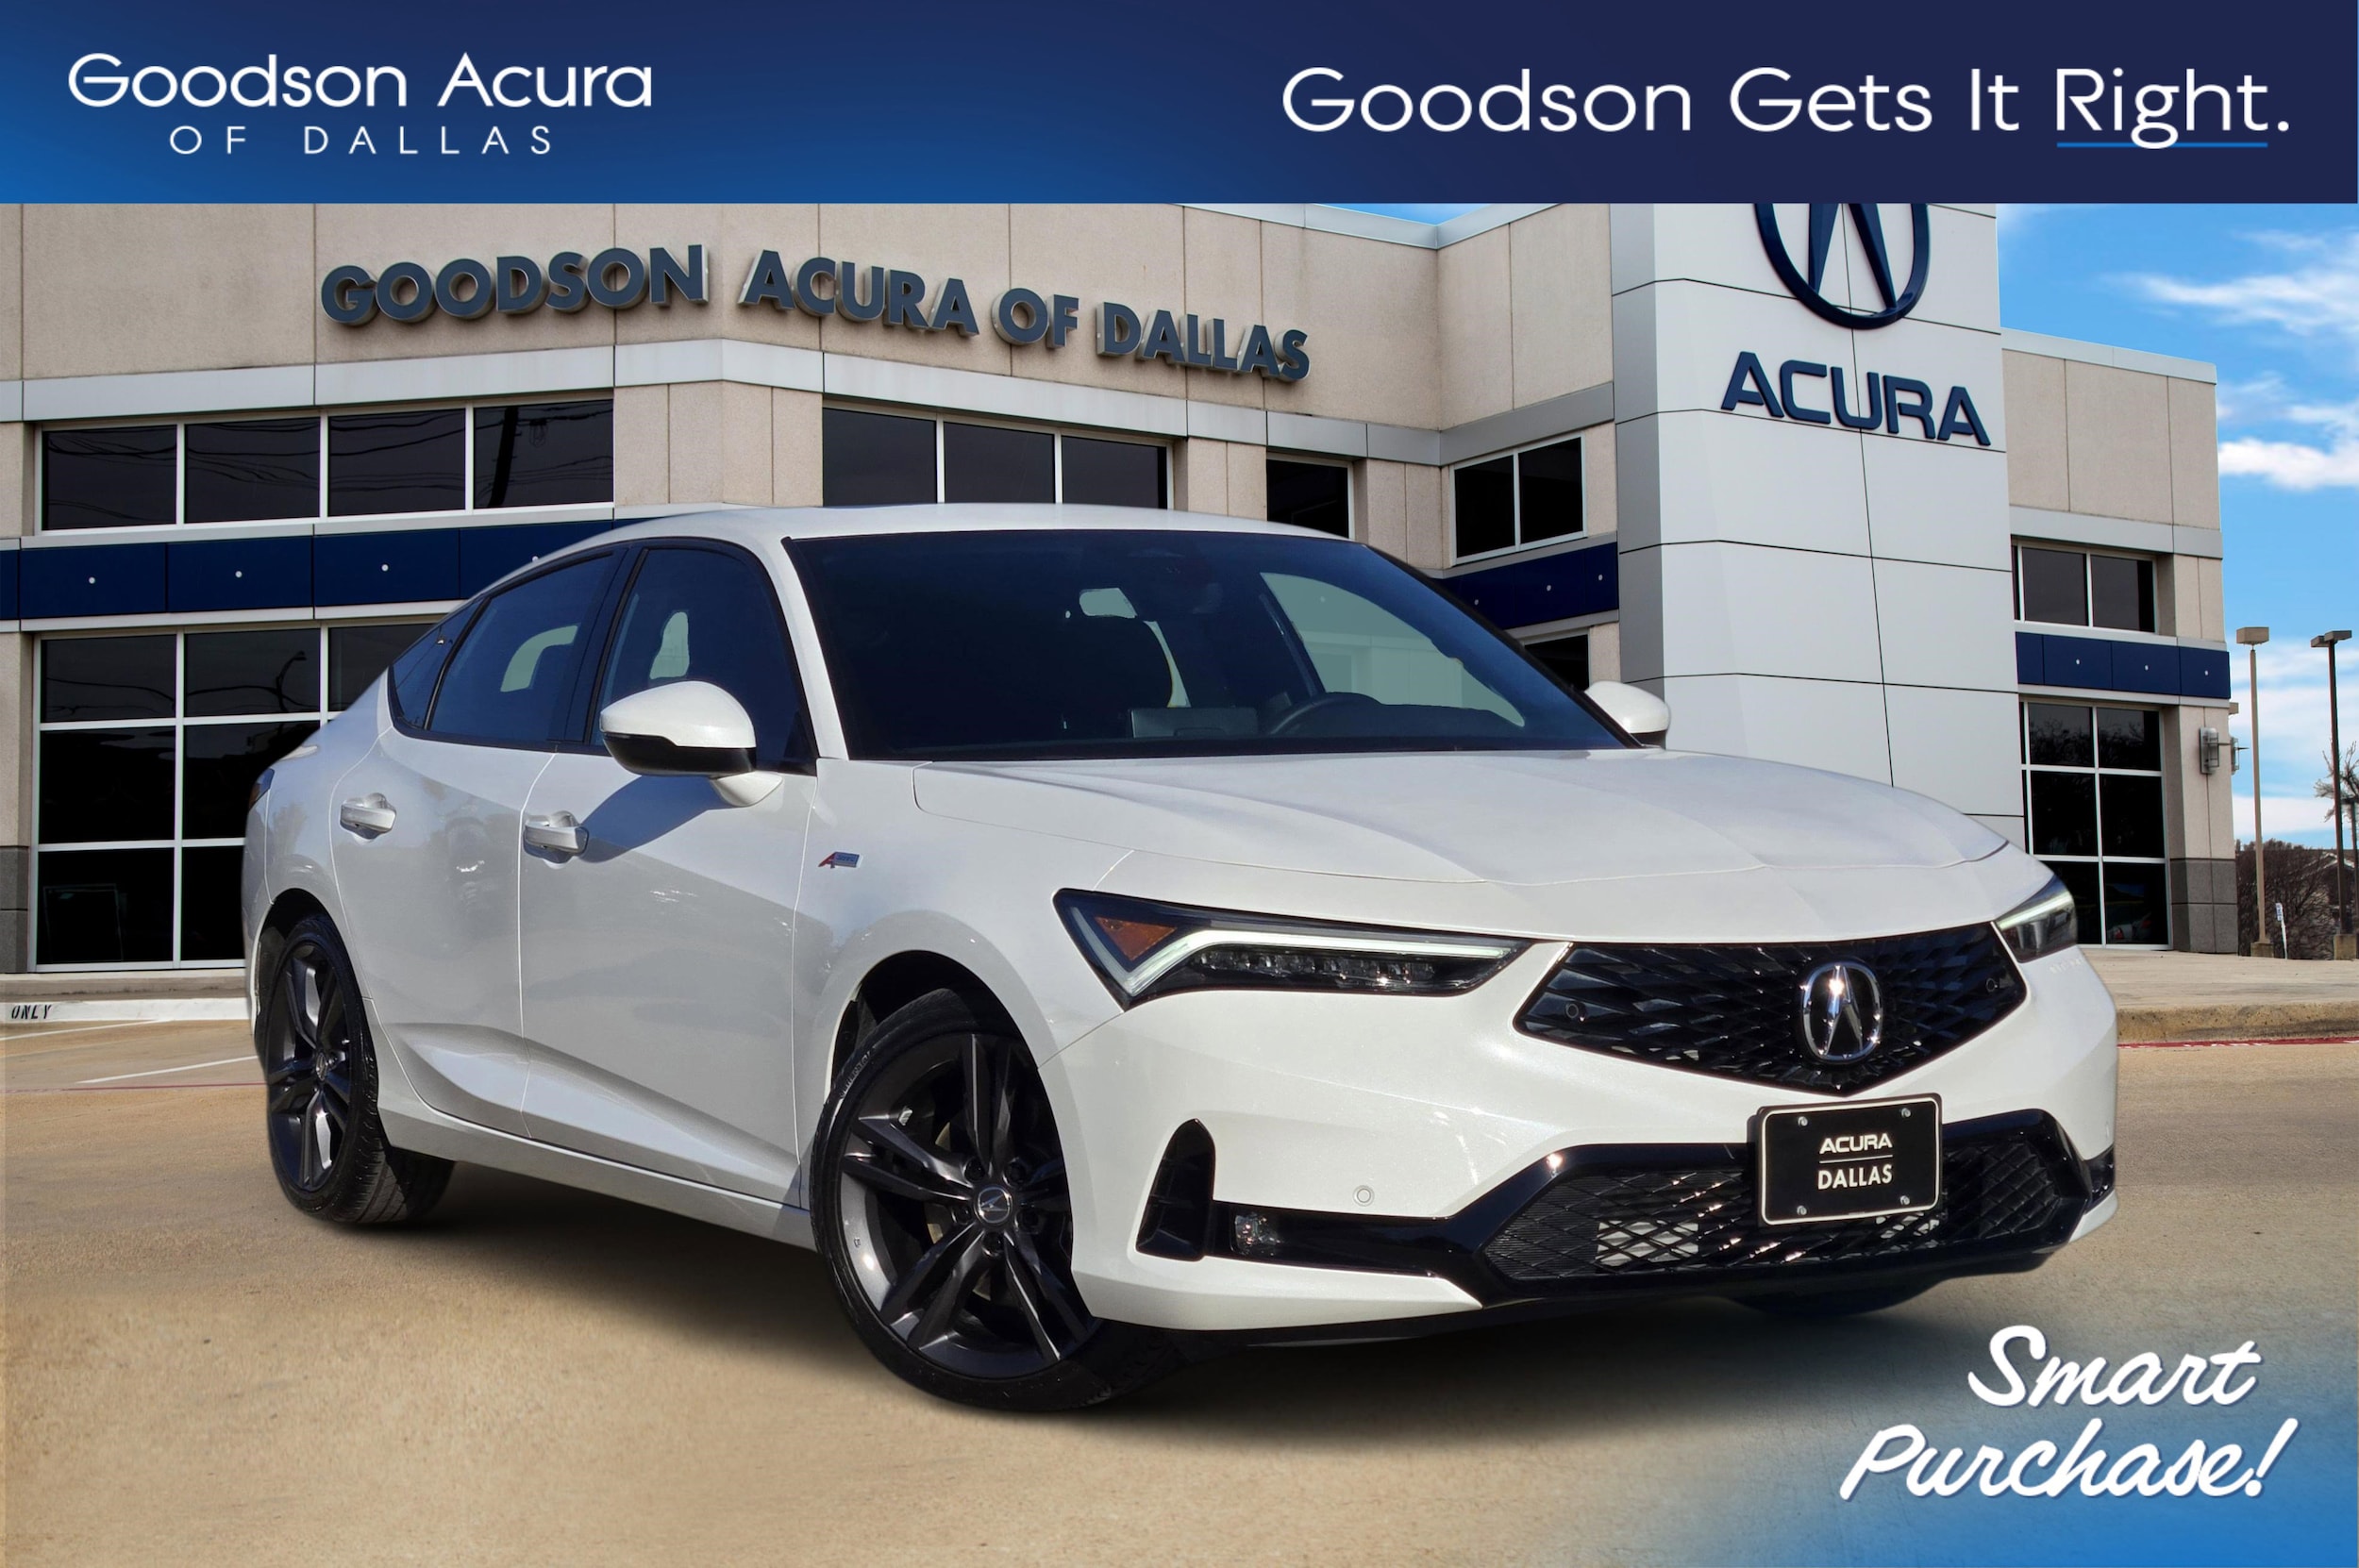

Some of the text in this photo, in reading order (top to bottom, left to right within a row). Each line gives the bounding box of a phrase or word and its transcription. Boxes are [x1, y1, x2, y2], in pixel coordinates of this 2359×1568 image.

[321, 243, 1312, 382] GOODSON ACURA OF DALLAS
[1720, 350, 1992, 447] ACURA
[11, 1004, 52, 1020] ONLY
[1818, 1132, 1893, 1155] ACURA
[1817, 1163, 1893, 1191] DALLAS
